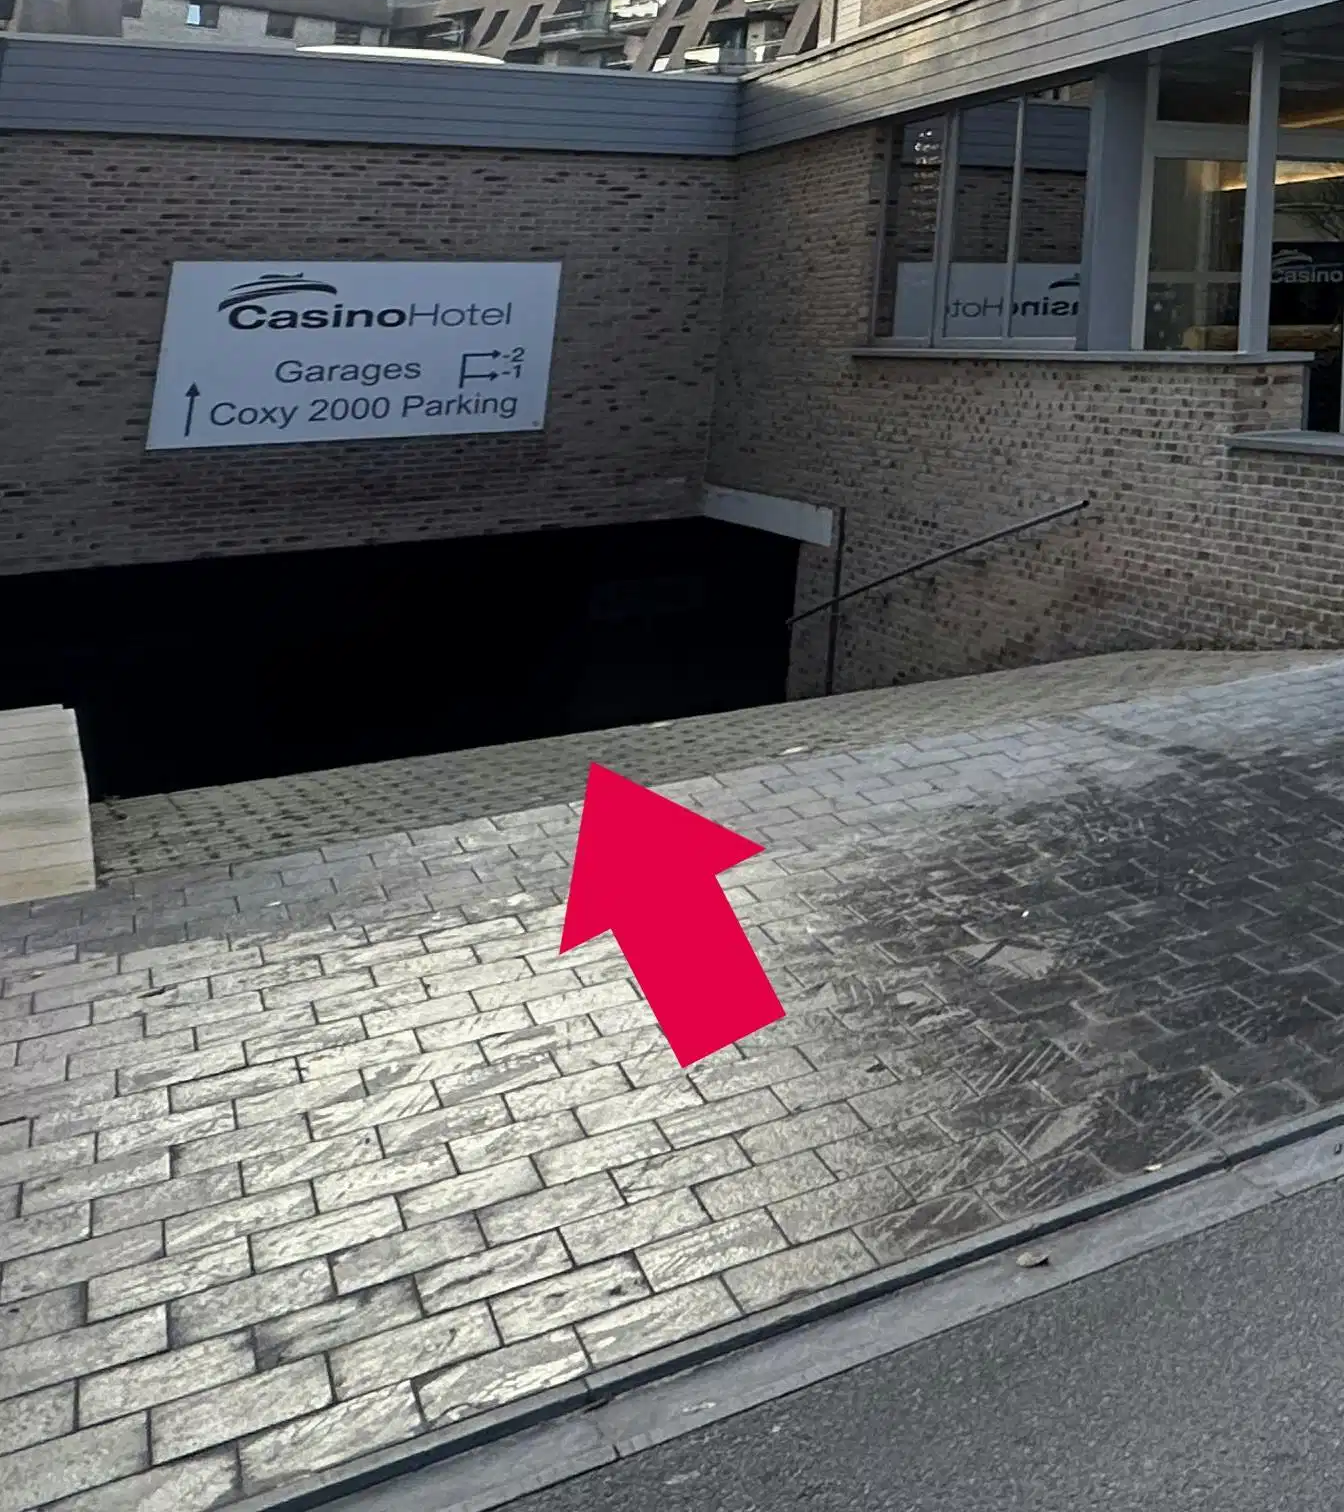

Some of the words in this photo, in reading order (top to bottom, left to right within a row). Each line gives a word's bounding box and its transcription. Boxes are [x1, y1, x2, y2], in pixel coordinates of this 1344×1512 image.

[228, 301, 513, 330] CasinoHotel
[275, 359, 421, 387] Garages
[210, 402, 299, 429] Coxy
[308, 396, 390, 422] 2000
[401, 392, 518, 420] Parking
